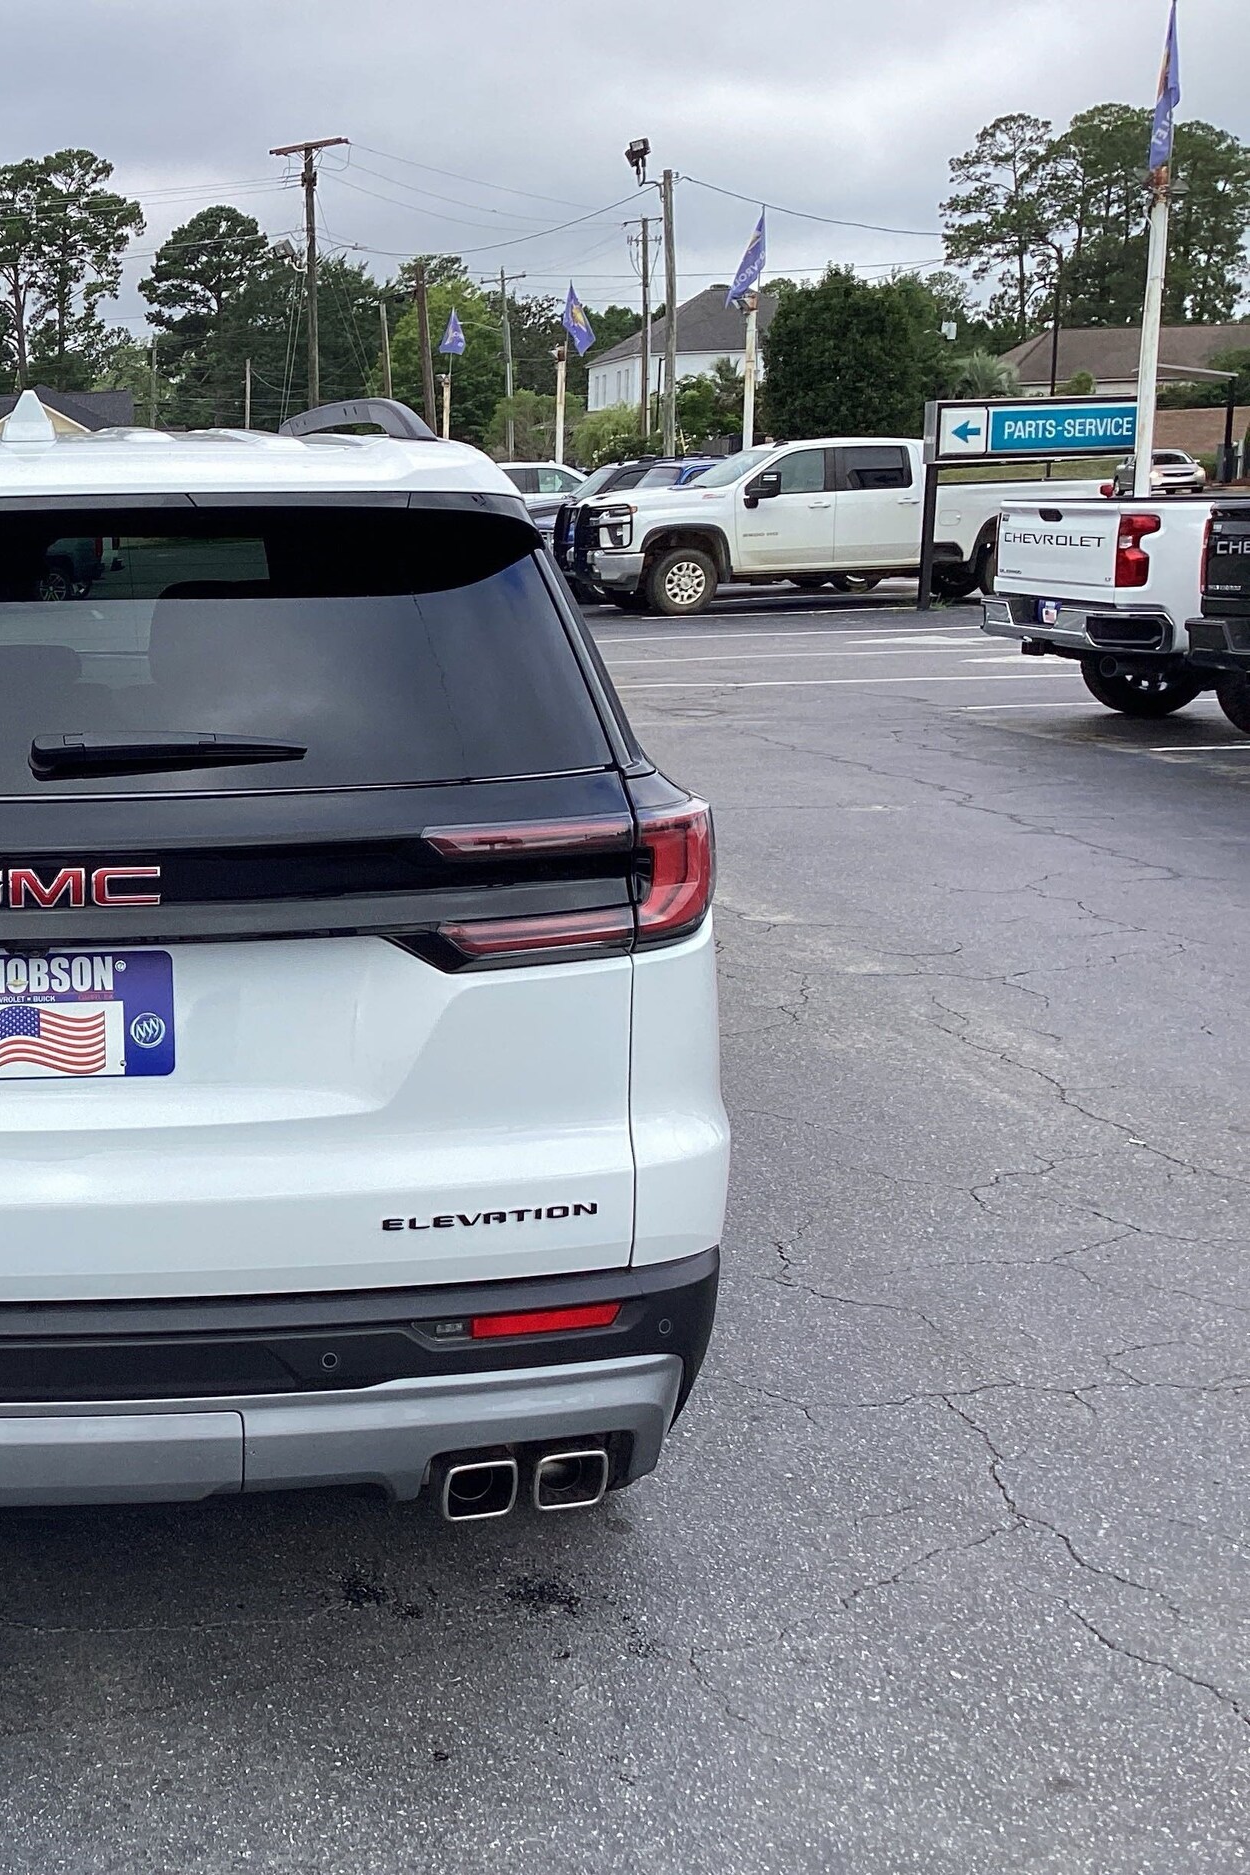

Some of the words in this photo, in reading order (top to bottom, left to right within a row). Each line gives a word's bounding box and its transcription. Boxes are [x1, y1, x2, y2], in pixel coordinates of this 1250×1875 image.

[1004, 417, 1134, 440] PARTS-SERVICE
[1004, 532, 1106, 547] CHEVROLET
[33, 995, 56, 1003] BUICK
[382, 1202, 598, 1231] ELEVATION
